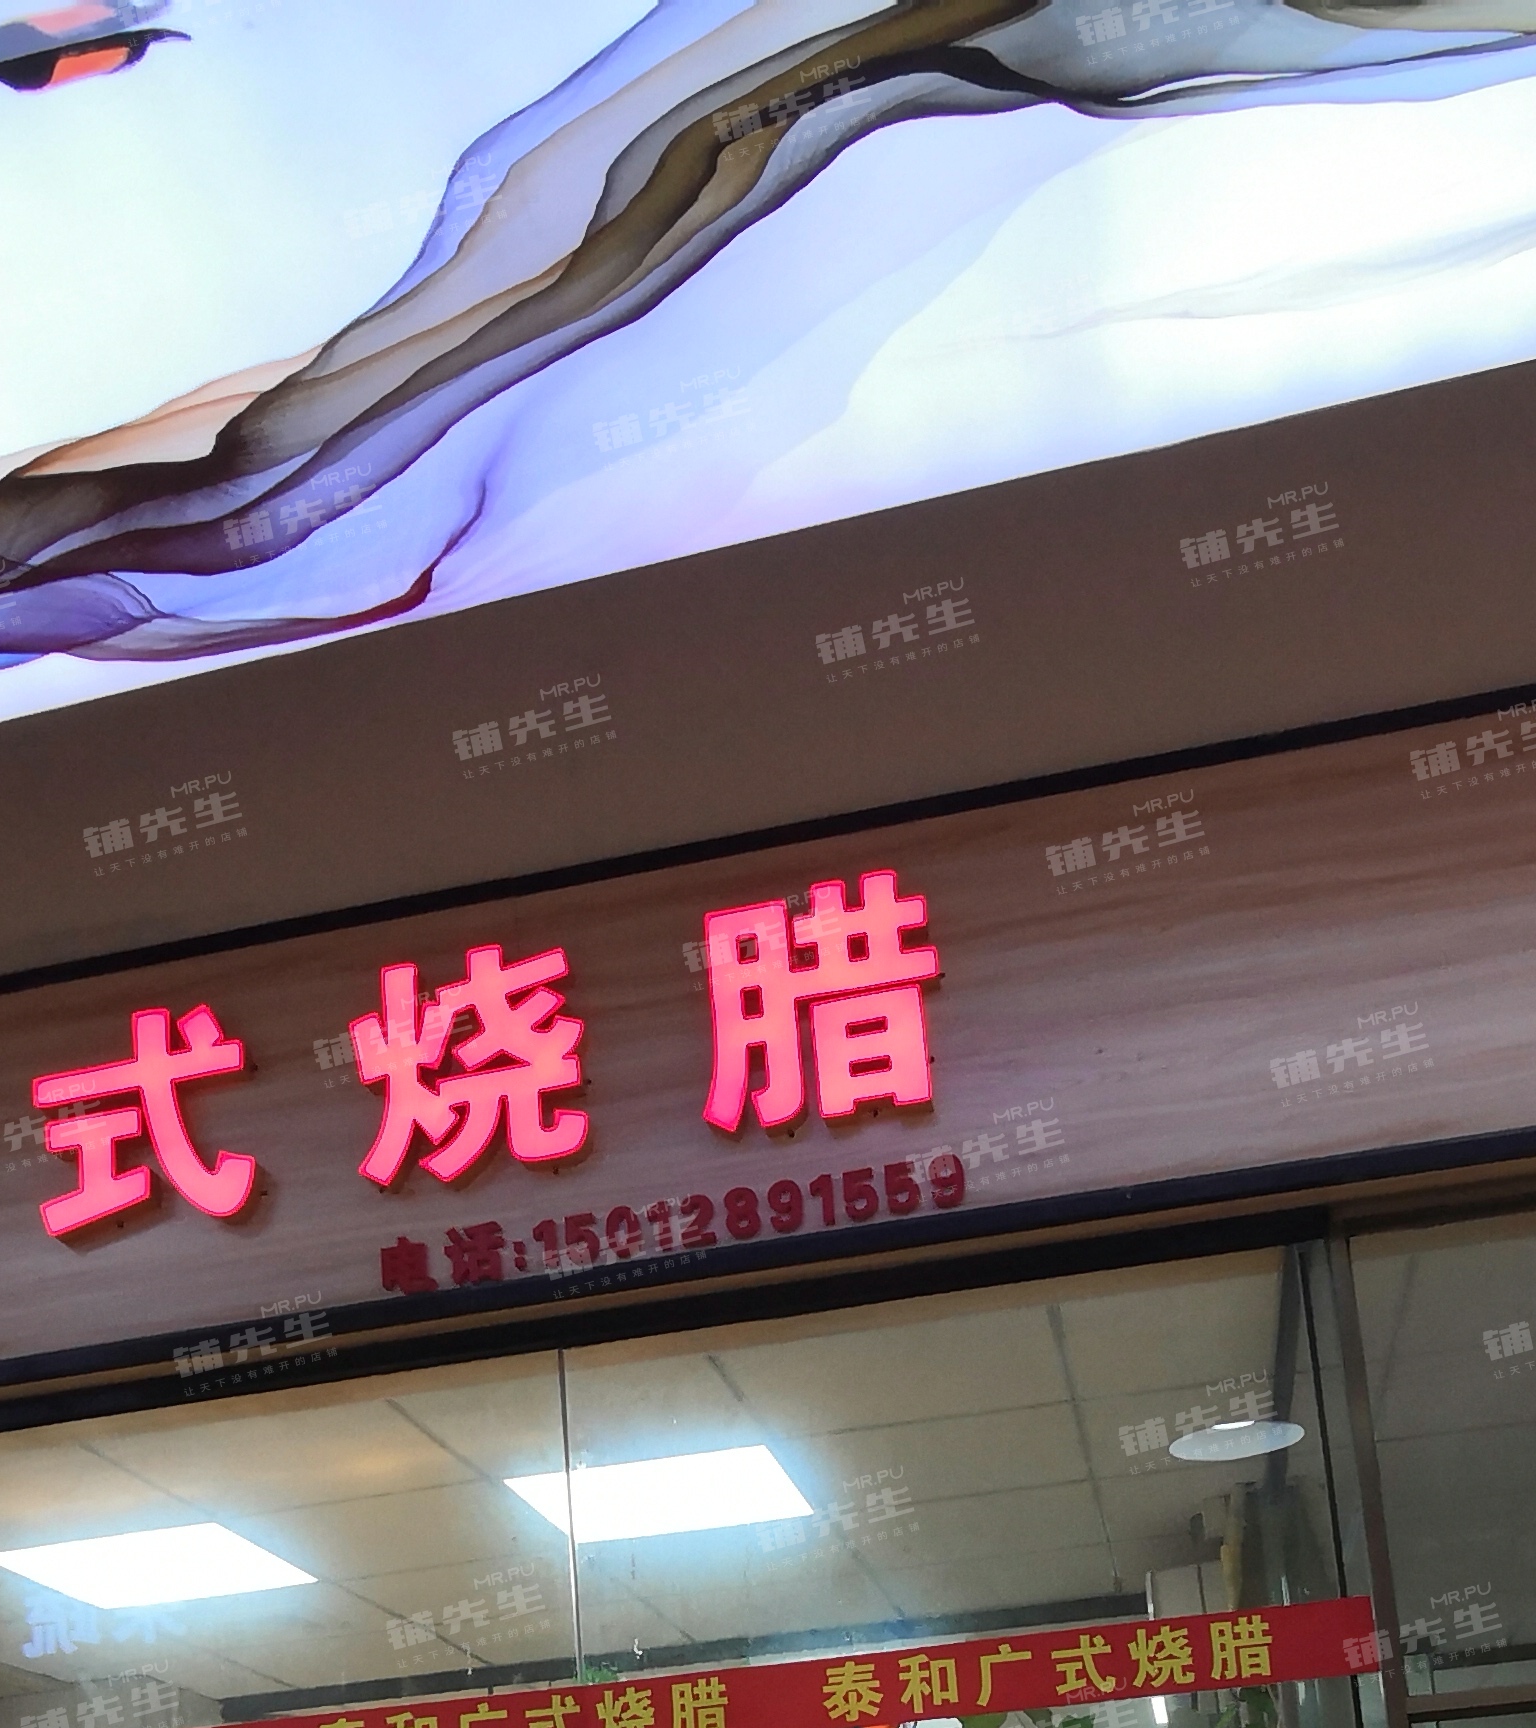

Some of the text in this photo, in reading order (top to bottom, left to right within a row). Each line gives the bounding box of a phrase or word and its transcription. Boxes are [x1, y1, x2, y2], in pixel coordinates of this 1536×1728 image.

[822, 1613, 1274, 1724] 泰和广式烧腊
